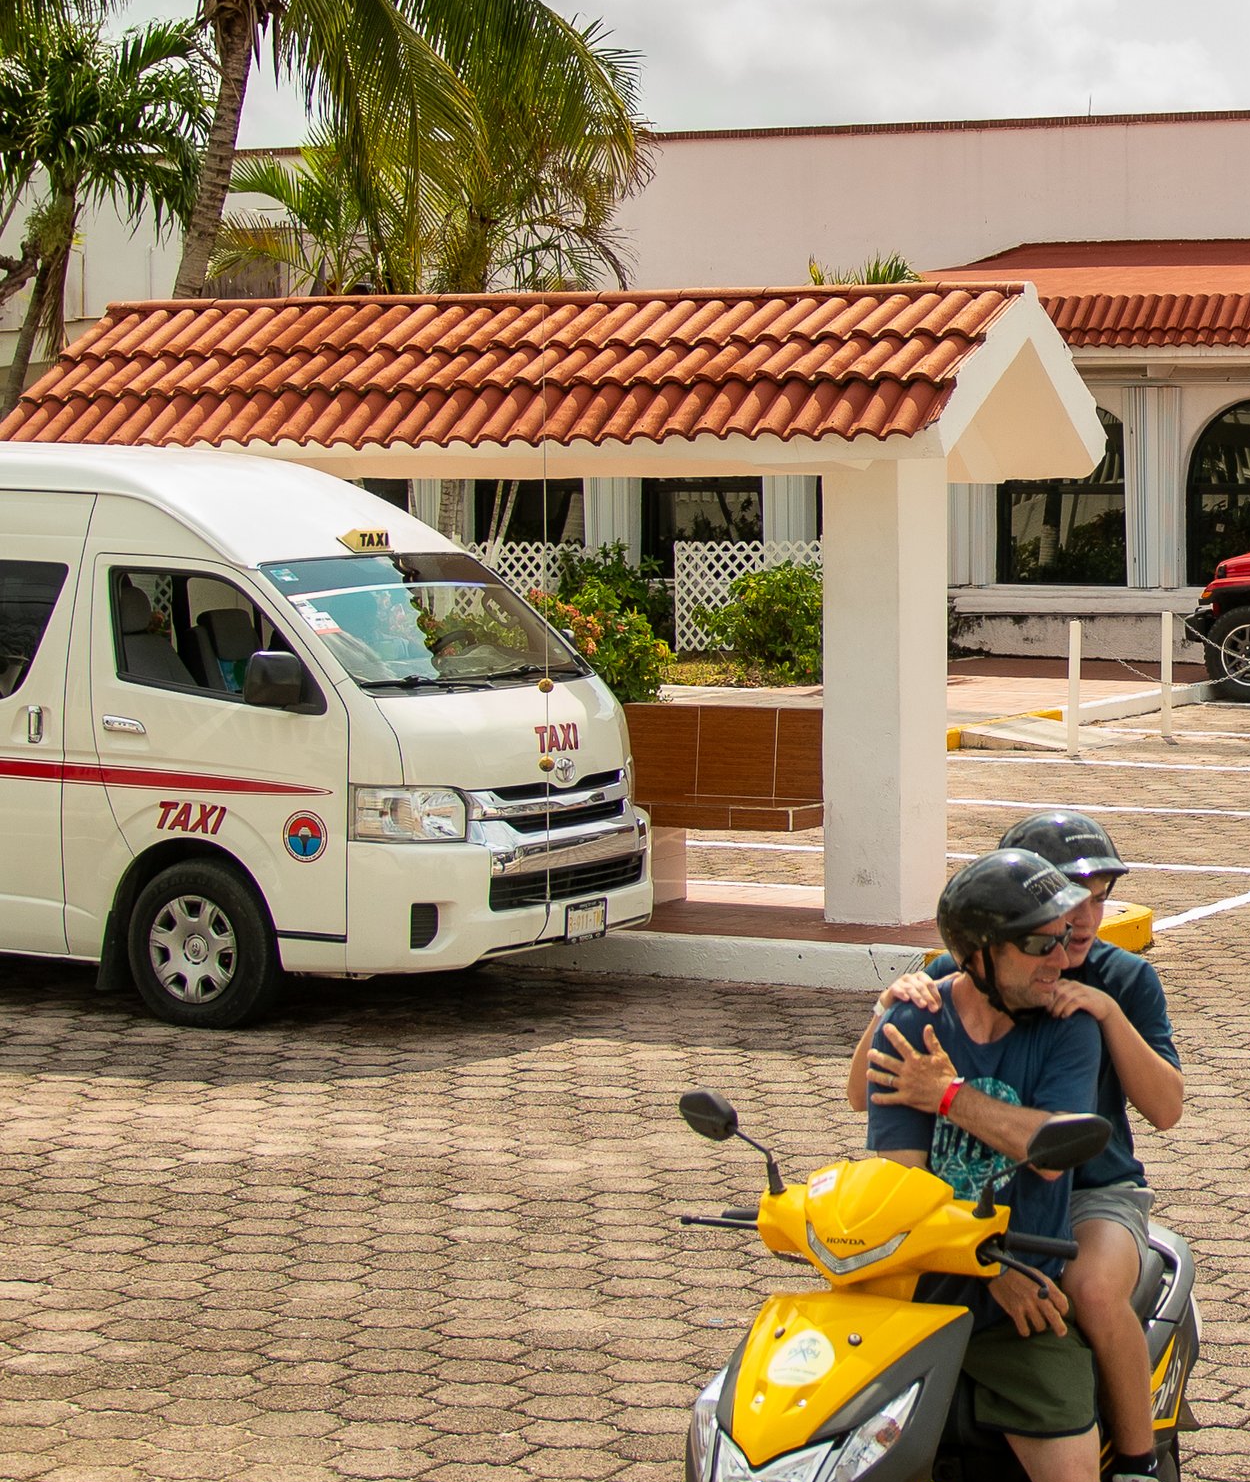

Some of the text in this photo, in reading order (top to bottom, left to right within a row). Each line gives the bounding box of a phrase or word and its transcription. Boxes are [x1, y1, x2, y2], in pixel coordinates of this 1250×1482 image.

[360, 532, 389, 547] TAXI
[534, 722, 579, 754] TAXI
[156, 801, 227, 835] TAXI
[826, 1237, 866, 1246] HONDA
